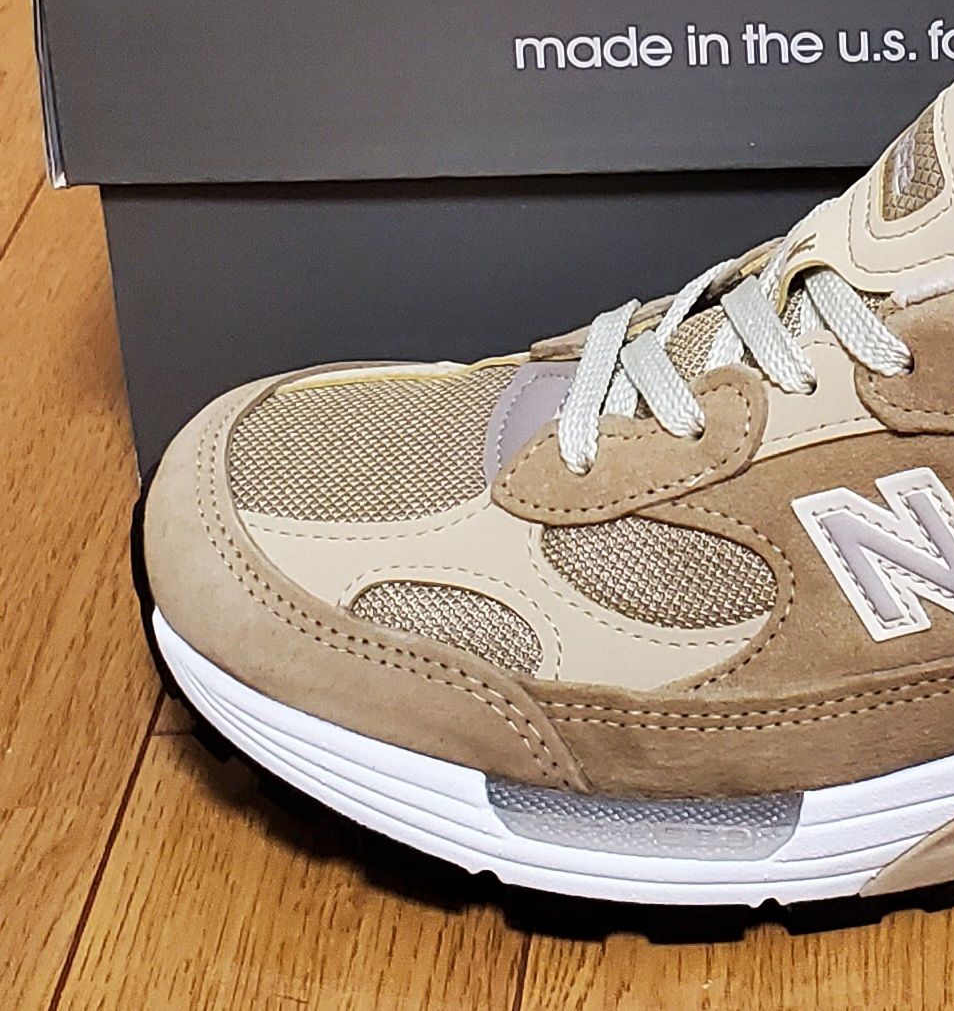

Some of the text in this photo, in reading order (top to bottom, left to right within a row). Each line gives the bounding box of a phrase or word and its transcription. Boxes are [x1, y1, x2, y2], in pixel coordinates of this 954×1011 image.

[514, 25, 673, 69] made
[687, 24, 730, 66] in
[742, 23, 824, 64] the
[838, 28, 917, 62] u.s.
